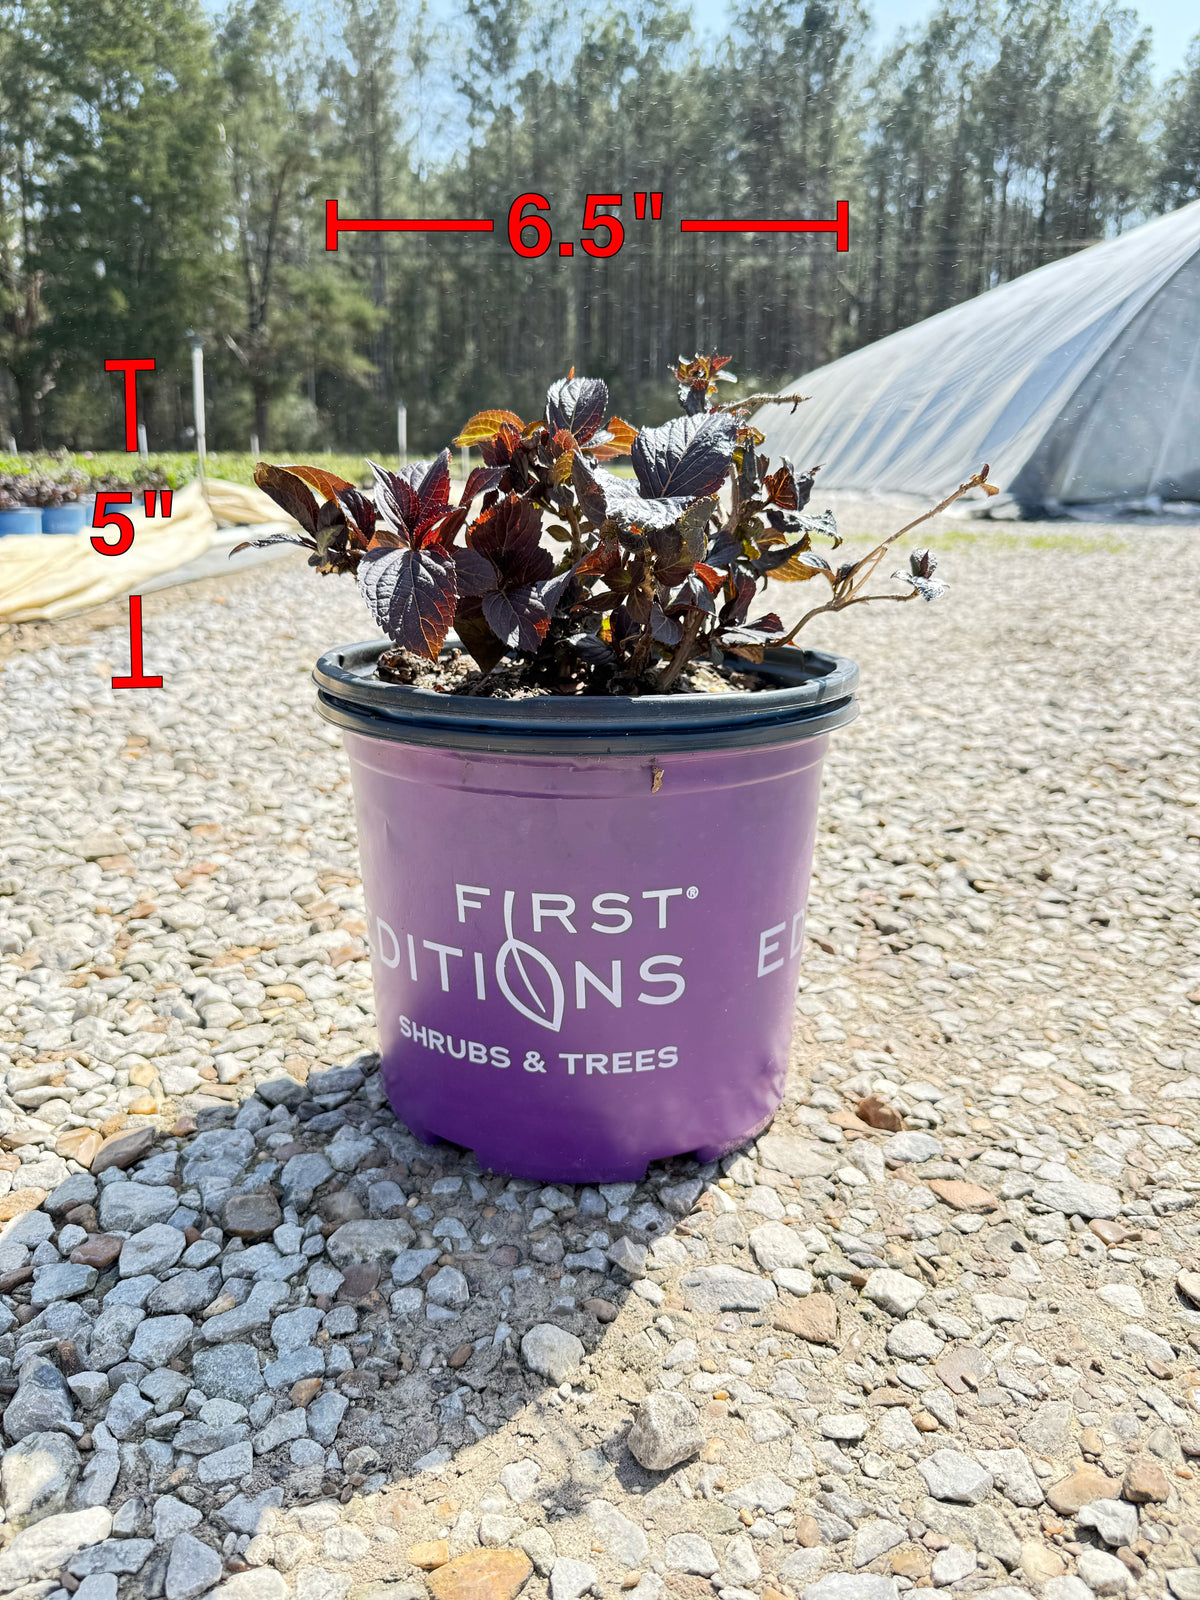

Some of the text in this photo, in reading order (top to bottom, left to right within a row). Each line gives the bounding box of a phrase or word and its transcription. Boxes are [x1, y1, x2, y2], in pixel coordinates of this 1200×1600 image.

[371, 915, 686, 1032] DITIONS
[398, 1014, 679, 1075] SHRUBS & TREES
